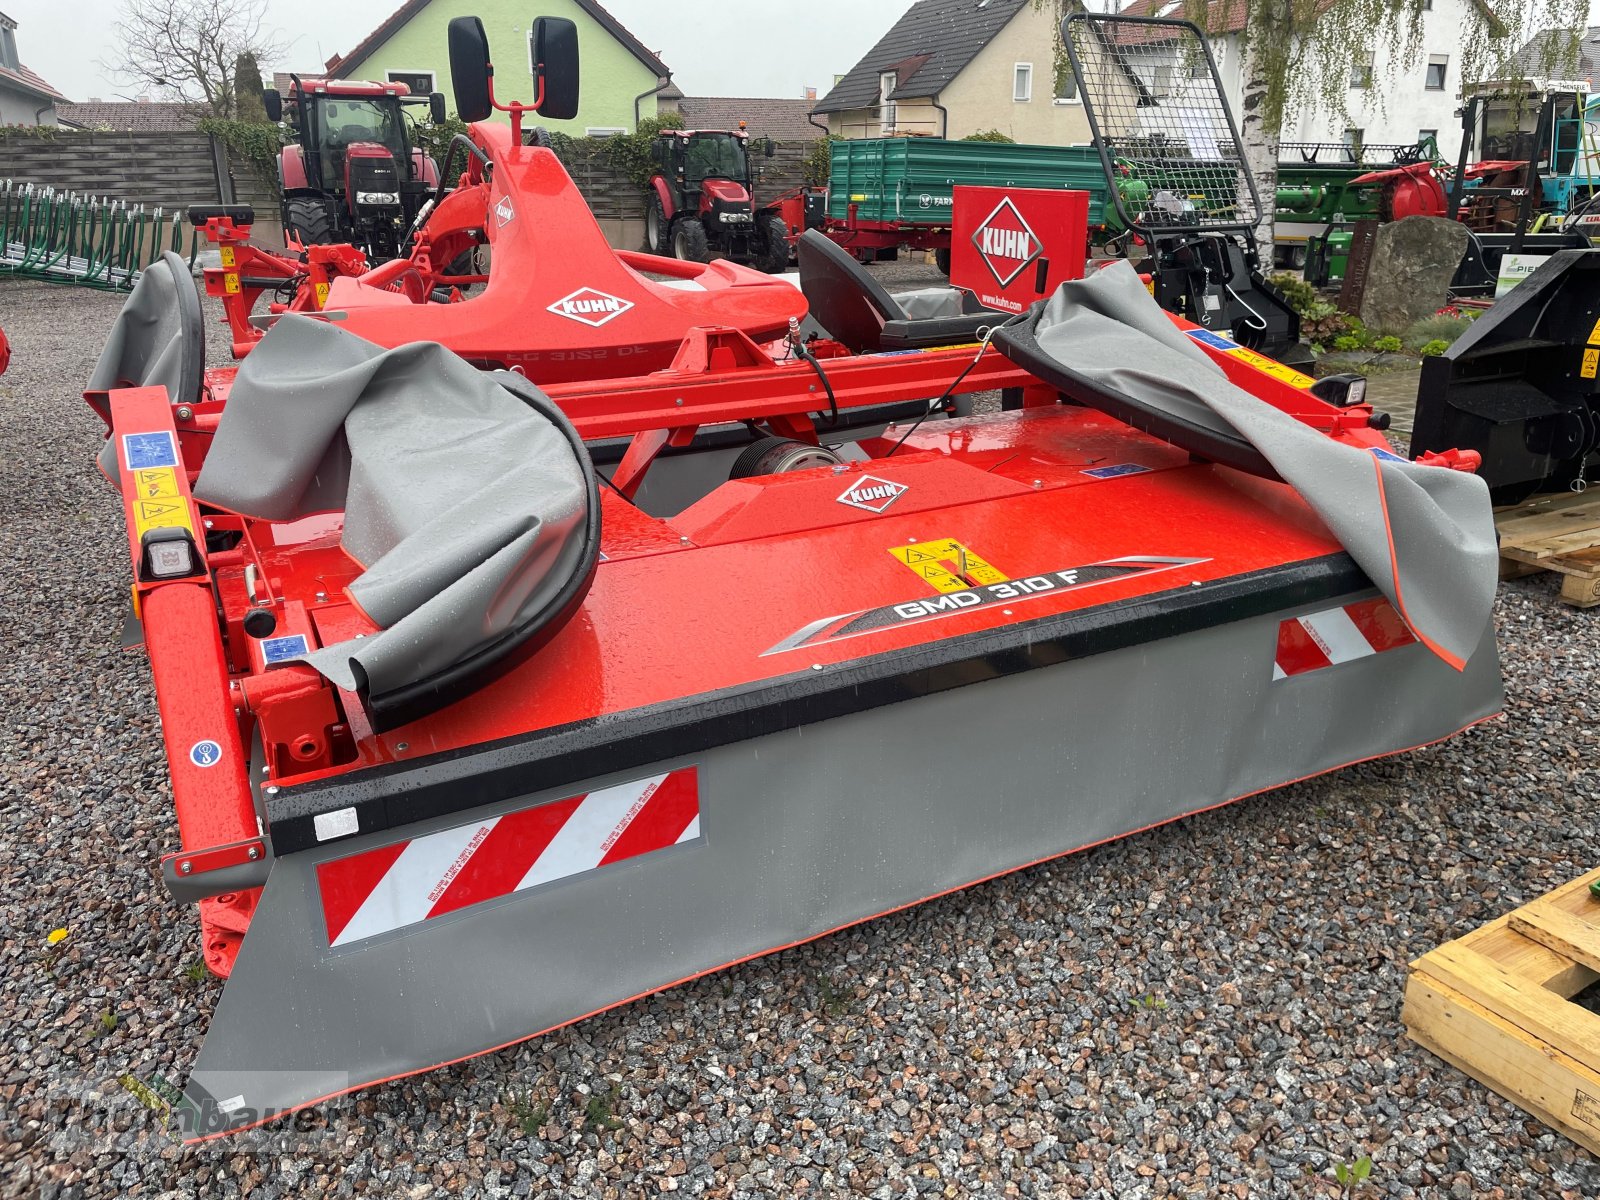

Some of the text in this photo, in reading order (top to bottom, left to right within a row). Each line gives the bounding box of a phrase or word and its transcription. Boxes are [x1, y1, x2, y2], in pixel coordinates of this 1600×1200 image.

[982, 226, 1030, 261] KUHN
[1517, 265, 1536, 273] PIE
[562, 298, 620, 314] KUHN
[982, 294, 1022, 312] www.kuhn.com
[849, 484, 898, 503] KUHN
[893, 569, 1079, 619] GMD 310 F
